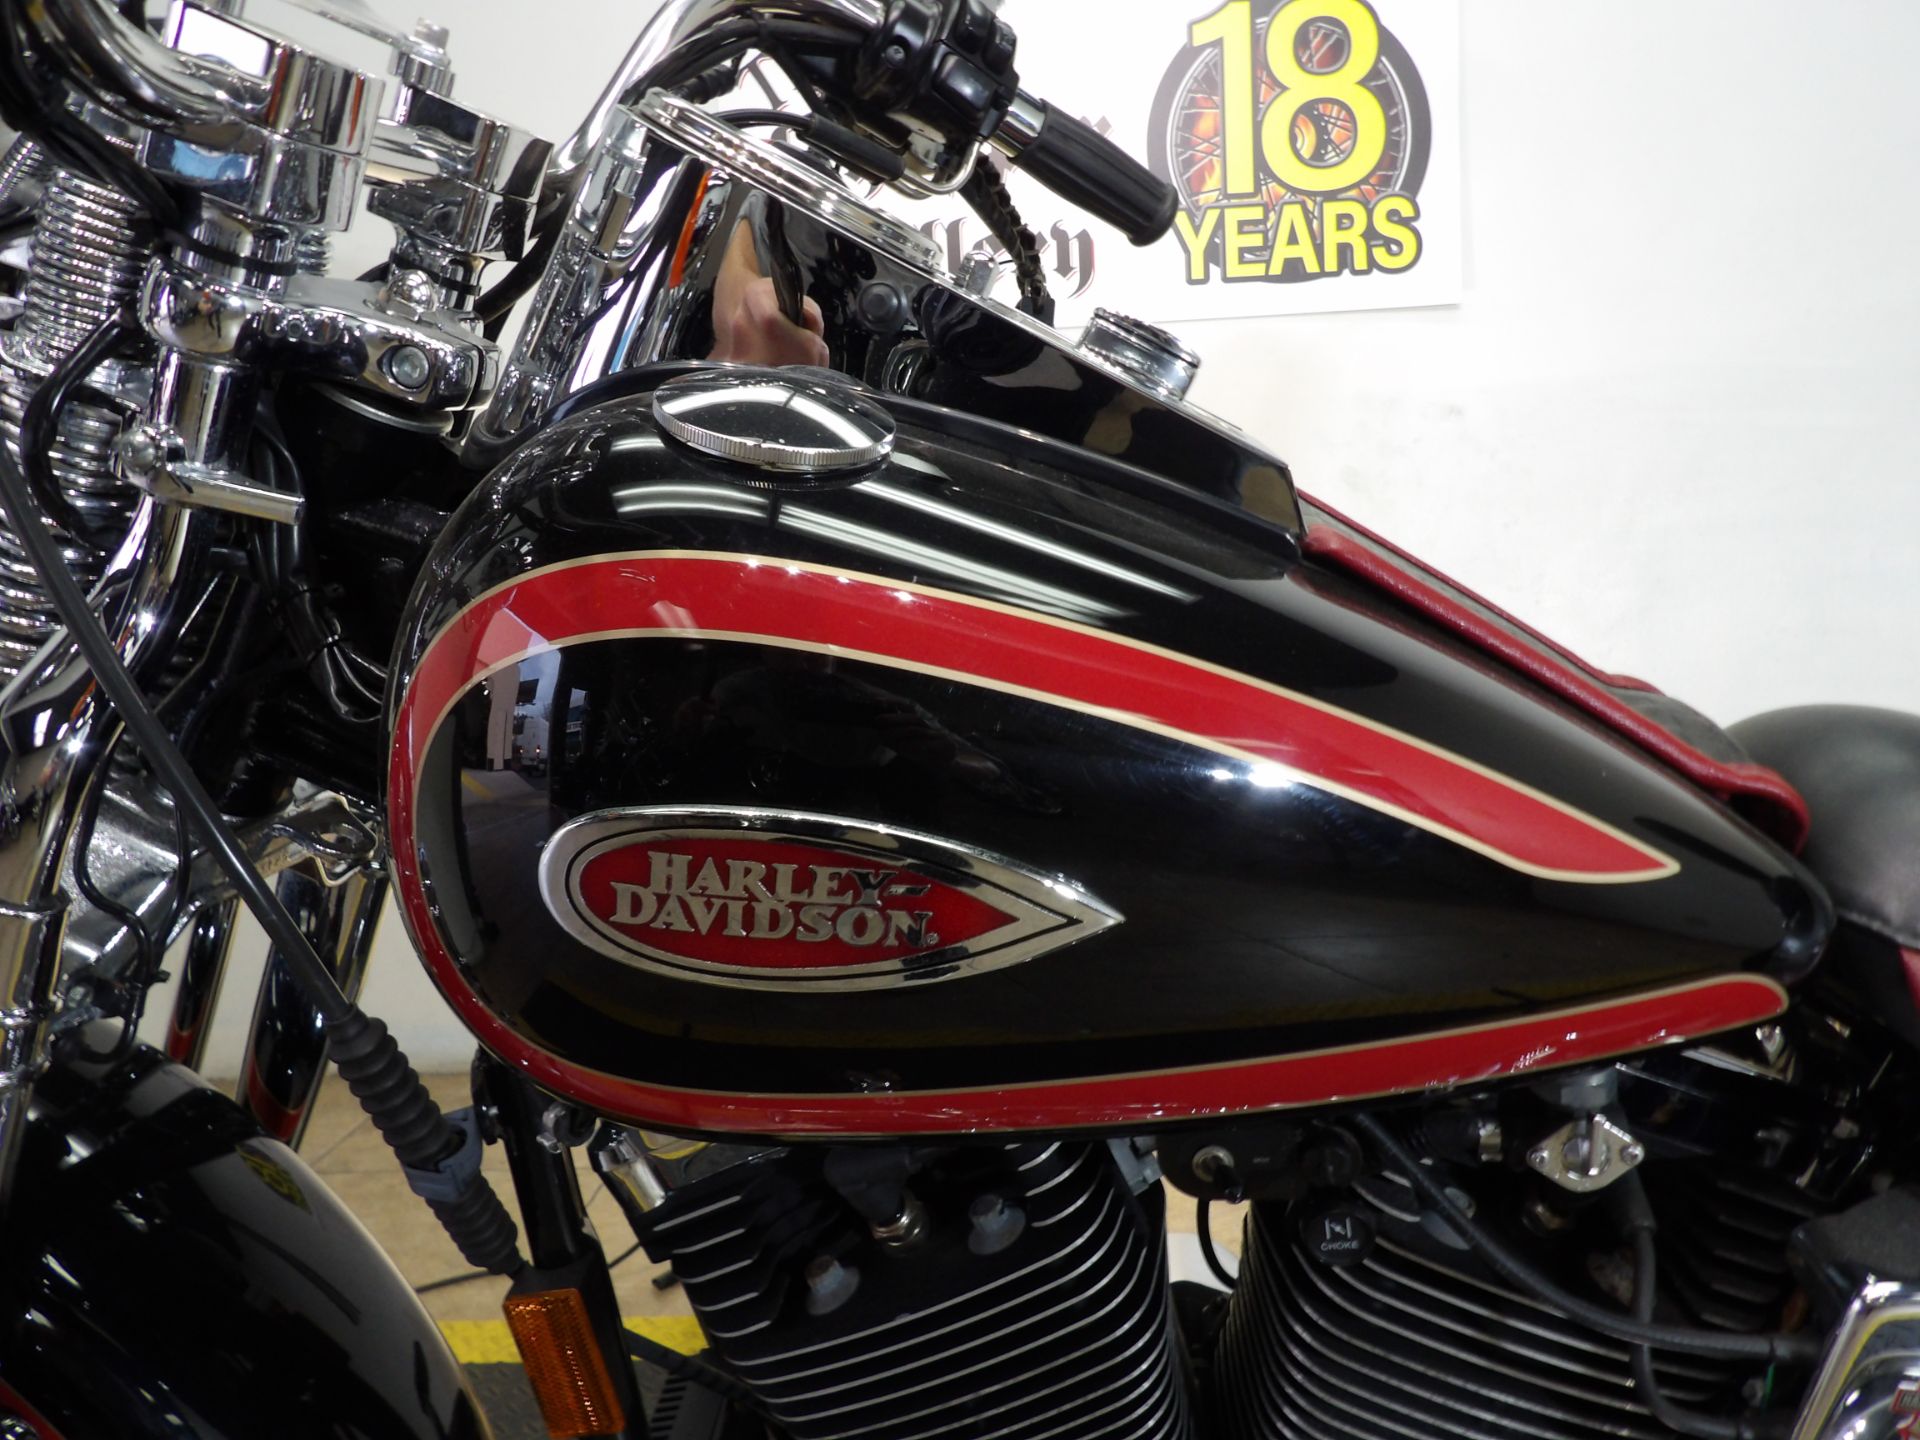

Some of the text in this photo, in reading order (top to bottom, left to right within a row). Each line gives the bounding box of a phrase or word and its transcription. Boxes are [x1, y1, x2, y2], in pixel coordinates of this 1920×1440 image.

[1189, 0, 1387, 196] 18
[1173, 193, 1420, 283] YEARS
[1320, 1240, 1360, 1252] CHOKE
